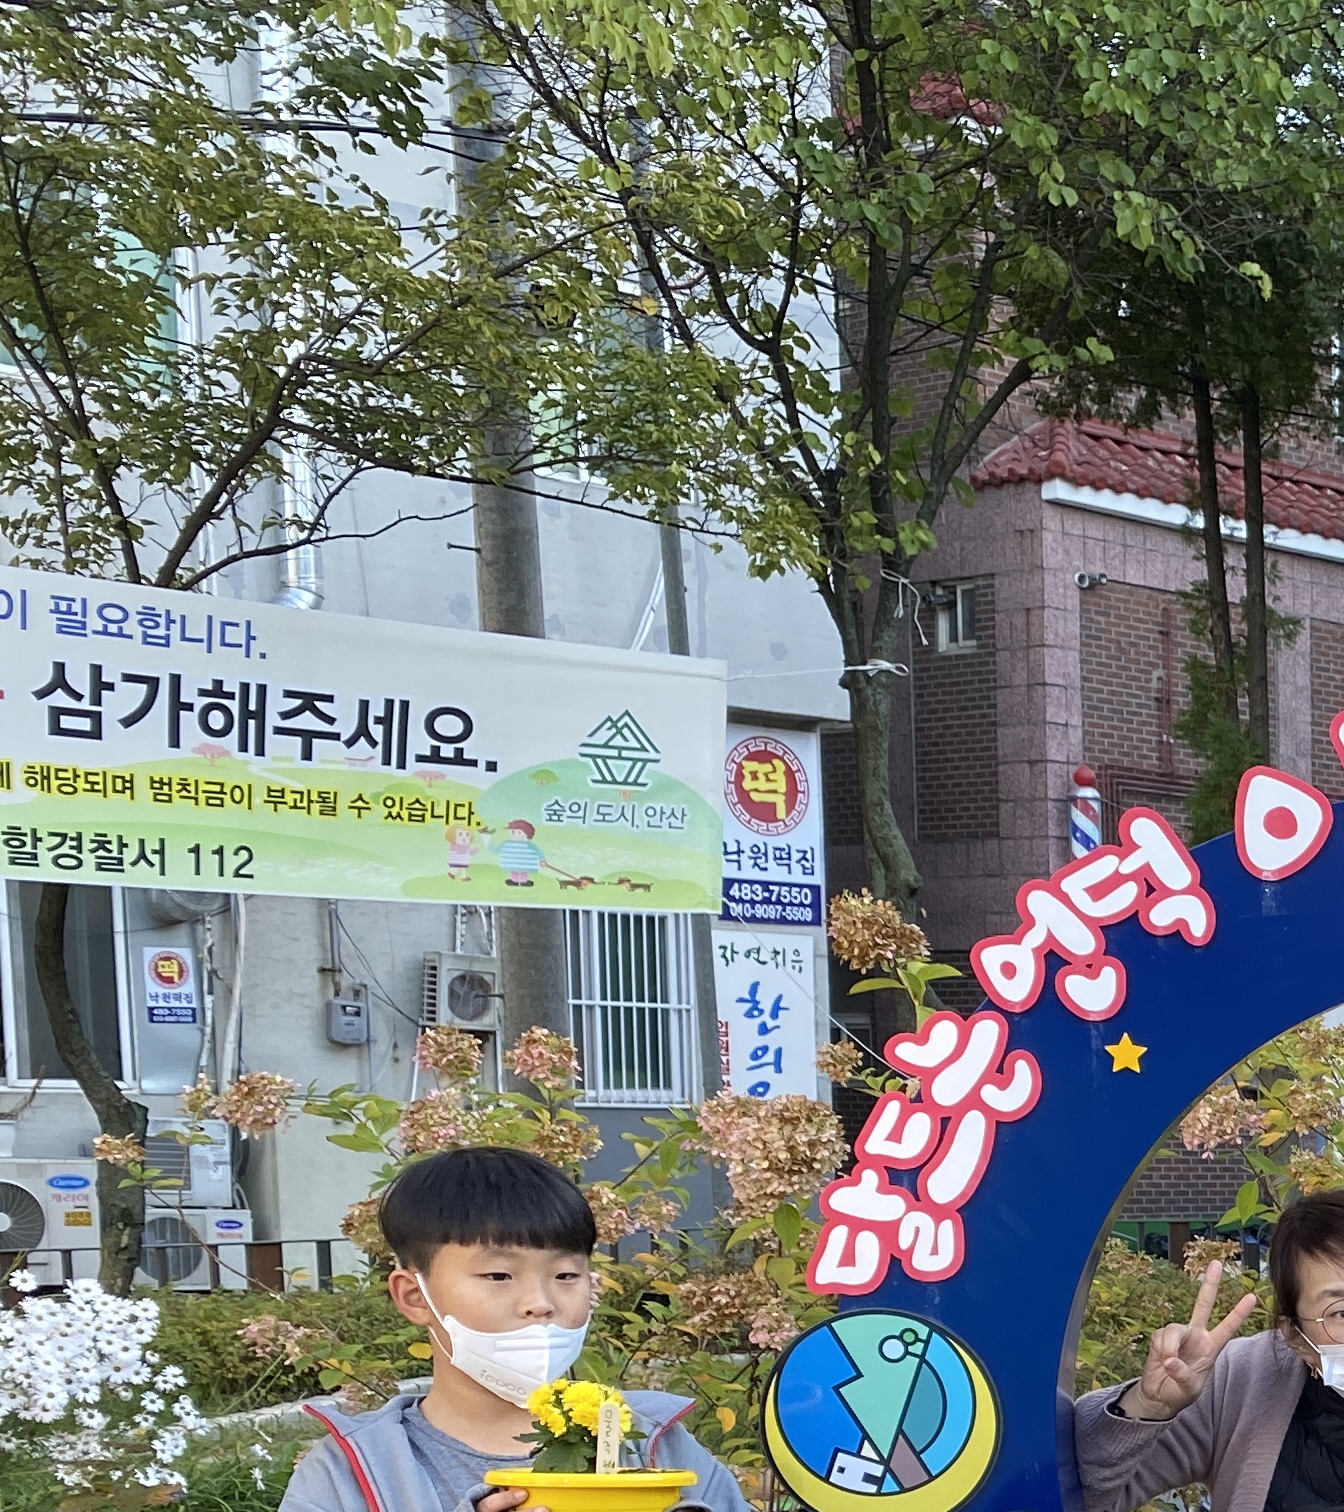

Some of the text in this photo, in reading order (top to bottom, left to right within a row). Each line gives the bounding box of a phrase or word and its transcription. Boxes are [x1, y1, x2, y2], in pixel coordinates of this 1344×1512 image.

[49, 594, 267, 660] 필요합니다.
[31, 660, 498, 773] 삼가해주세요.
[24, 762, 135, 800] 해당되며
[150, 776, 252, 810] 범칙금이
[264, 786, 338, 817] 부과될
[348, 793, 371, 818] 수
[382, 796, 482, 828] 있습니다.
[741, 759, 787, 820] 떡
[544, 798, 688, 830] 숲의 도시, 안산
[1, 824, 255, 879] 할경찰서 112
[722, 838, 815, 876] 낙원떡집
[729, 882, 812, 905] 483-7550
[730, 902, 813, 922] 010-9097-5509
[970, 806, 1216, 1020] 언덕
[157, 959, 179, 983] 떡
[718, 942, 804, 973] 자연치유
[149, 992, 193, 1004] 낙원떡집
